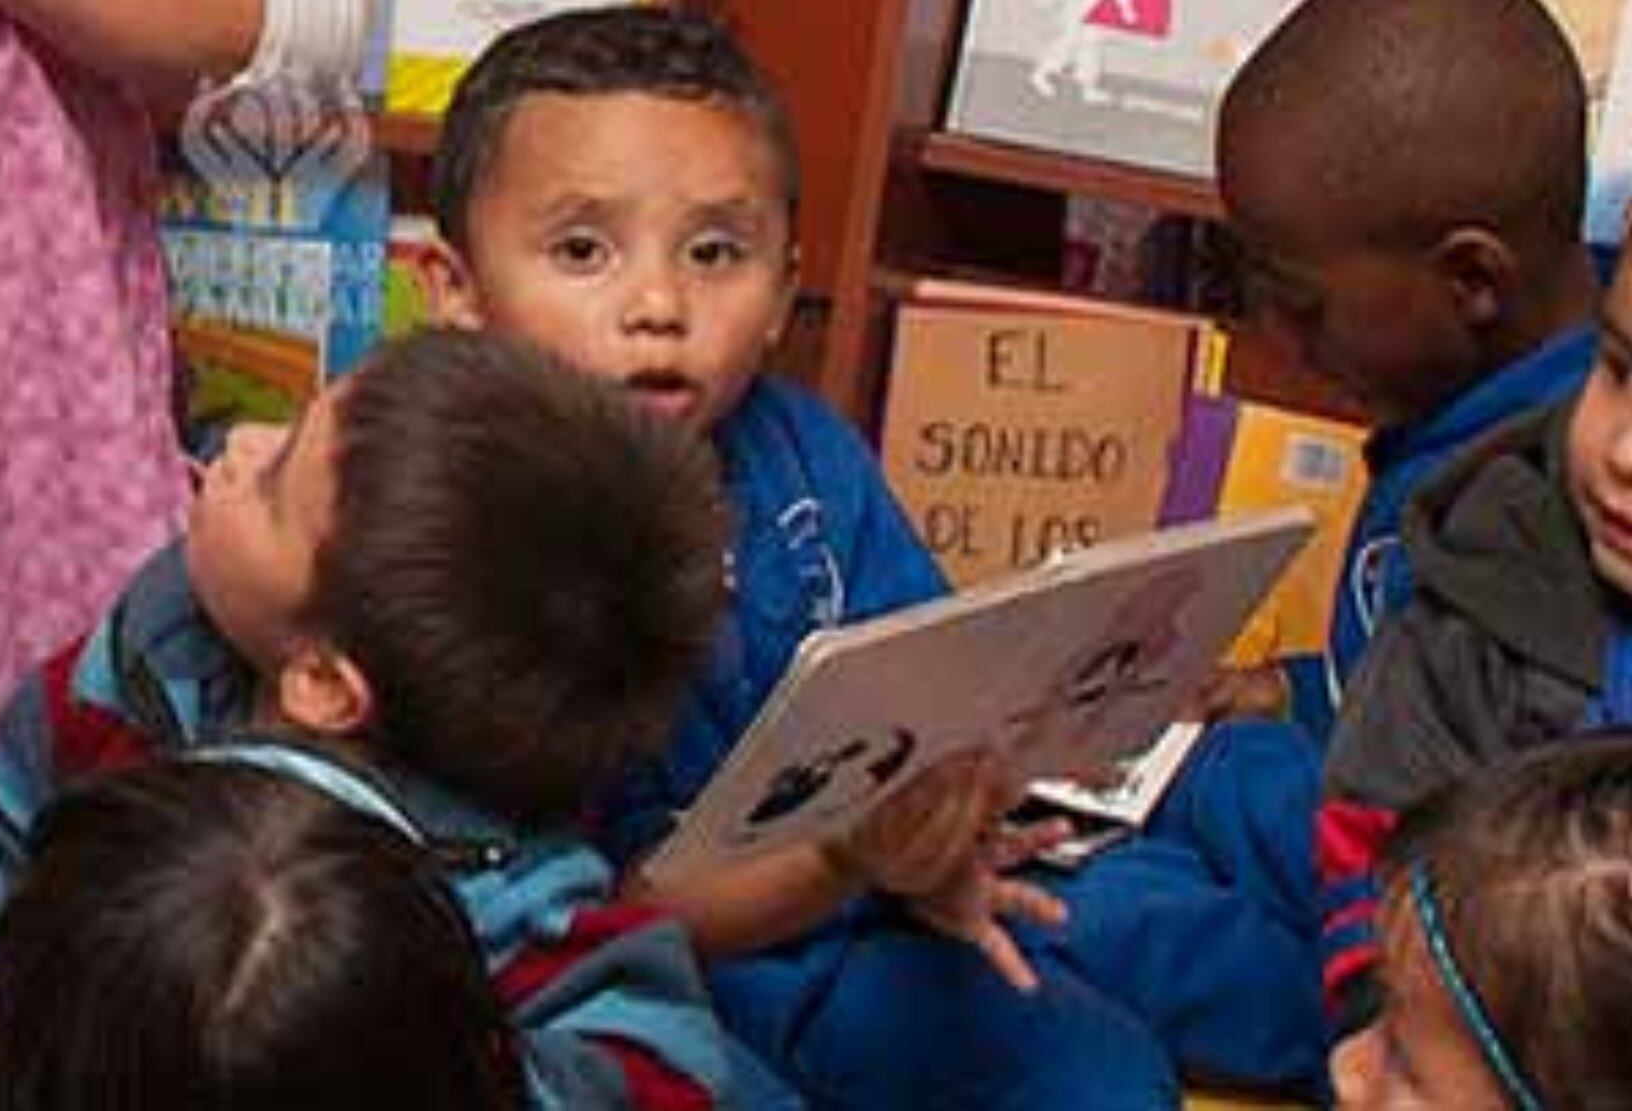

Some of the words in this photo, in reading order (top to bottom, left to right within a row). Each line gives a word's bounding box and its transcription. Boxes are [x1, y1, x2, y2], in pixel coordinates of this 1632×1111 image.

[986, 328, 1065, 394] EL
[916, 420, 1128, 488] SONIDO
[923, 501, 988, 558] DE
